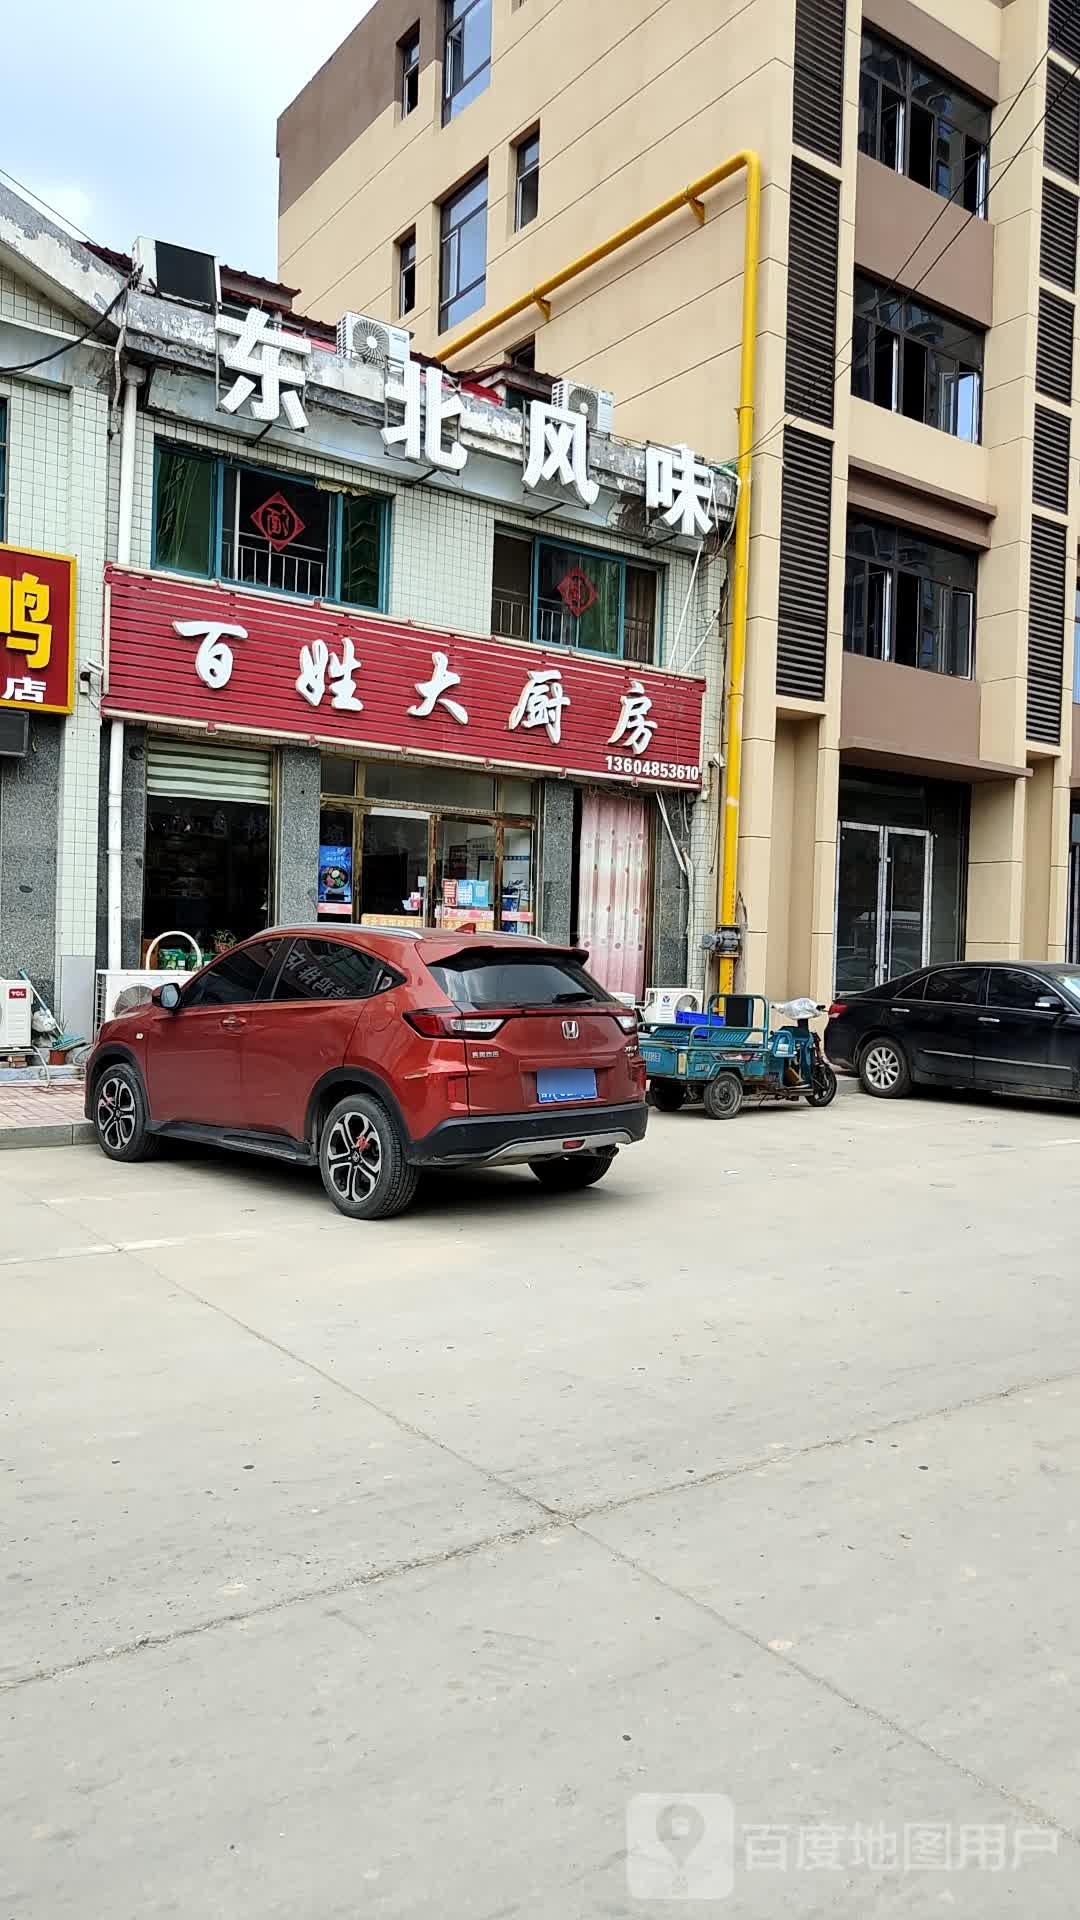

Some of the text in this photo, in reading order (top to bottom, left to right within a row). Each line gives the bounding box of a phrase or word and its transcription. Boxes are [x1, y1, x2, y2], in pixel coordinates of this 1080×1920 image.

[216, 308, 715, 535] 东北风味
[2, 677, 47, 703] 店
[172, 620, 658, 755] 百姓大厨房
[604, 755, 700, 781] 13604853610
